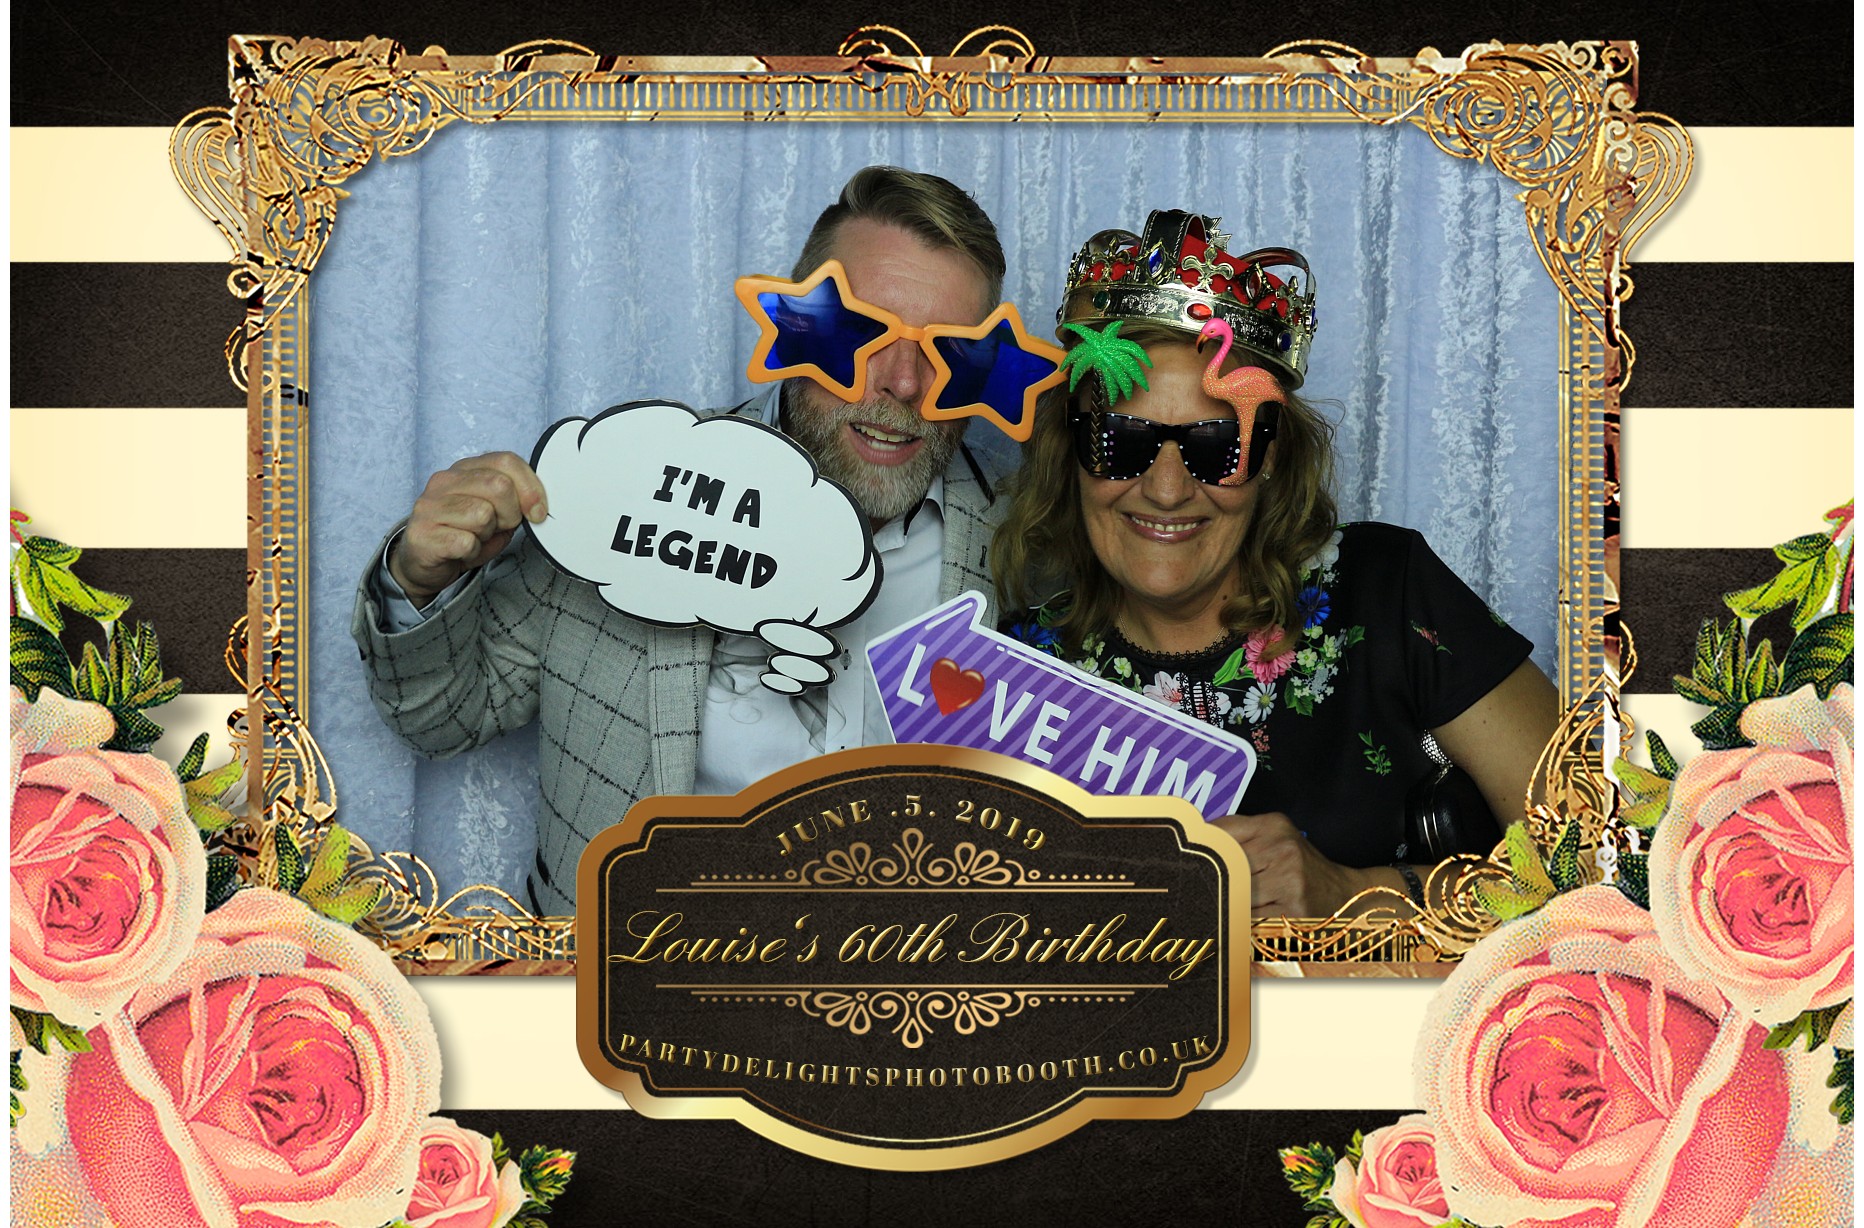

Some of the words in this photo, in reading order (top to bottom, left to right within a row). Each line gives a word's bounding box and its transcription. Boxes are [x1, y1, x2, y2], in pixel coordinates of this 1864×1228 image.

[652, 464, 726, 516] I'M
[732, 488, 761, 529] A
[610, 514, 778, 590] LEGEND
[1079, 725, 1217, 814] HIM
